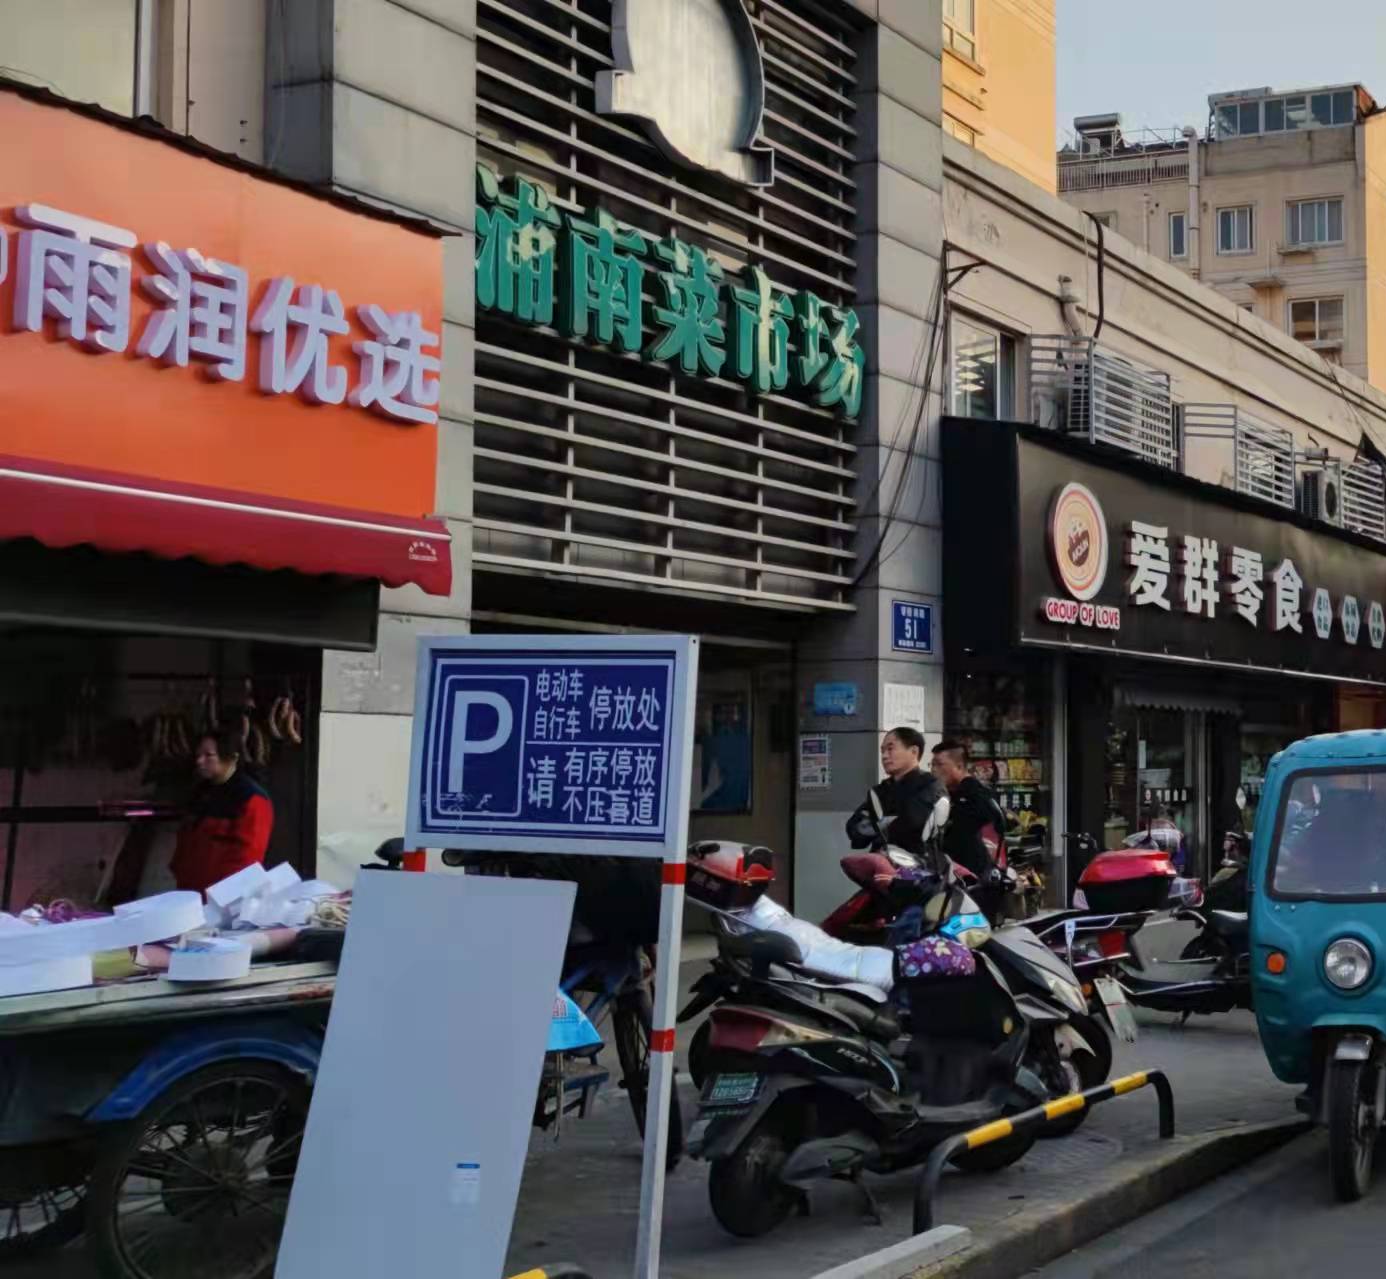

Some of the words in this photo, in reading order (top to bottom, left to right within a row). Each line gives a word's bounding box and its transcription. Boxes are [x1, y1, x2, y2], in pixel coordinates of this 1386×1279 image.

[475, 162, 866, 420] 浦南菜市场
[13, 202, 441, 425] 雨润优选
[1129, 520, 1303, 634] 爱群零食
[904, 617, 917, 640] 51
[1047, 600, 1078, 622] GROUP
[1080, 604, 1094, 625] OF
[1097, 607, 1119, 628] LOVE
[535, 668, 584, 703] 电动车
[533, 706, 582, 740] 自行车
[589, 685, 661, 731] 停放处
[448, 690, 514, 793] P
[526, 755, 557, 809] 请
[564, 747, 656, 786] 有序停放
[562, 786, 655, 825] 不压盲道
